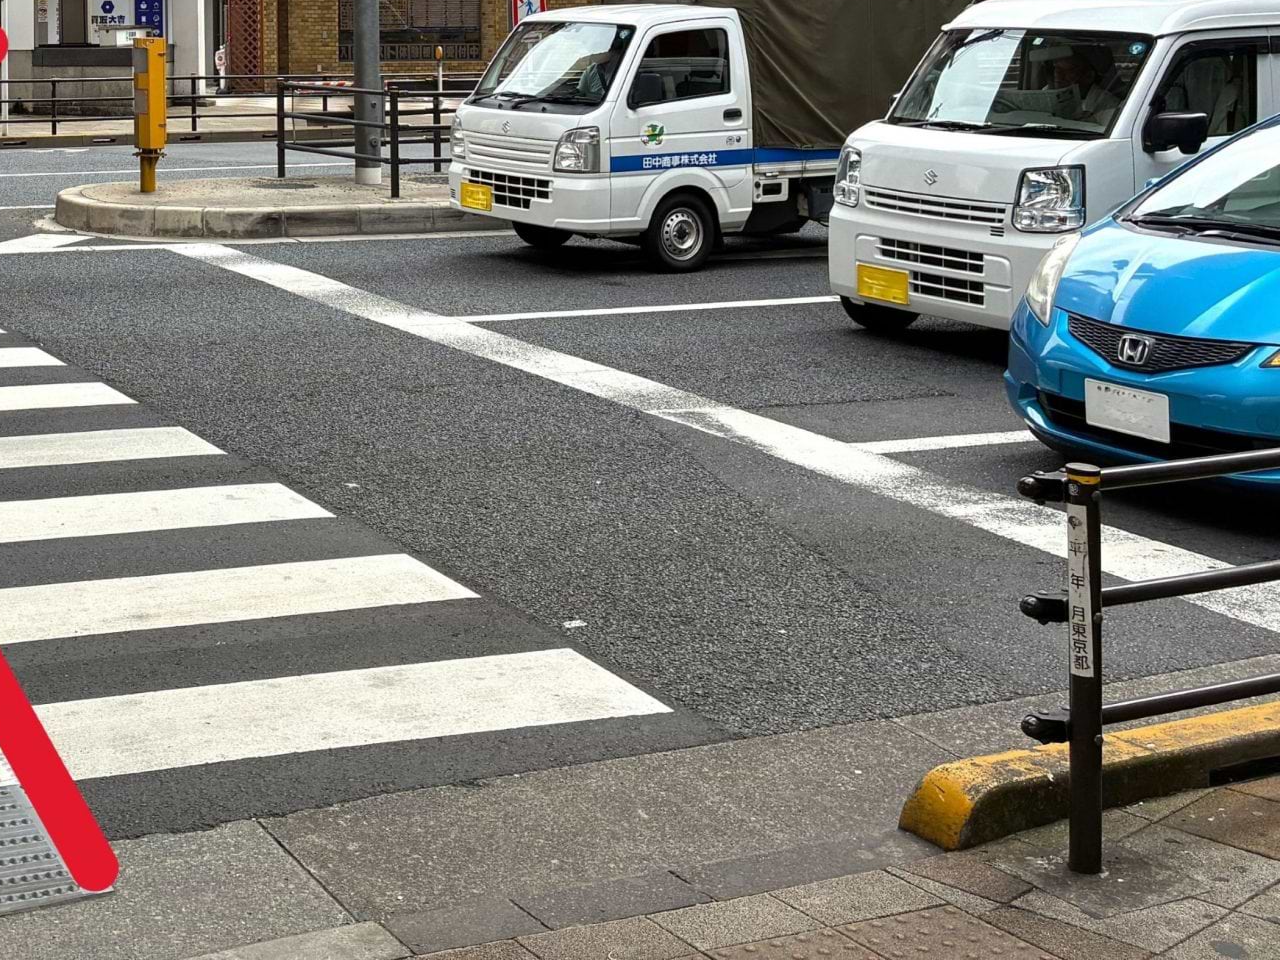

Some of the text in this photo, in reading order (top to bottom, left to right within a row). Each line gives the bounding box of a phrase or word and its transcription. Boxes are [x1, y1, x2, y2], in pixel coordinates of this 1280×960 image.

[642, 152, 718, 169] 田中商事株式会社
